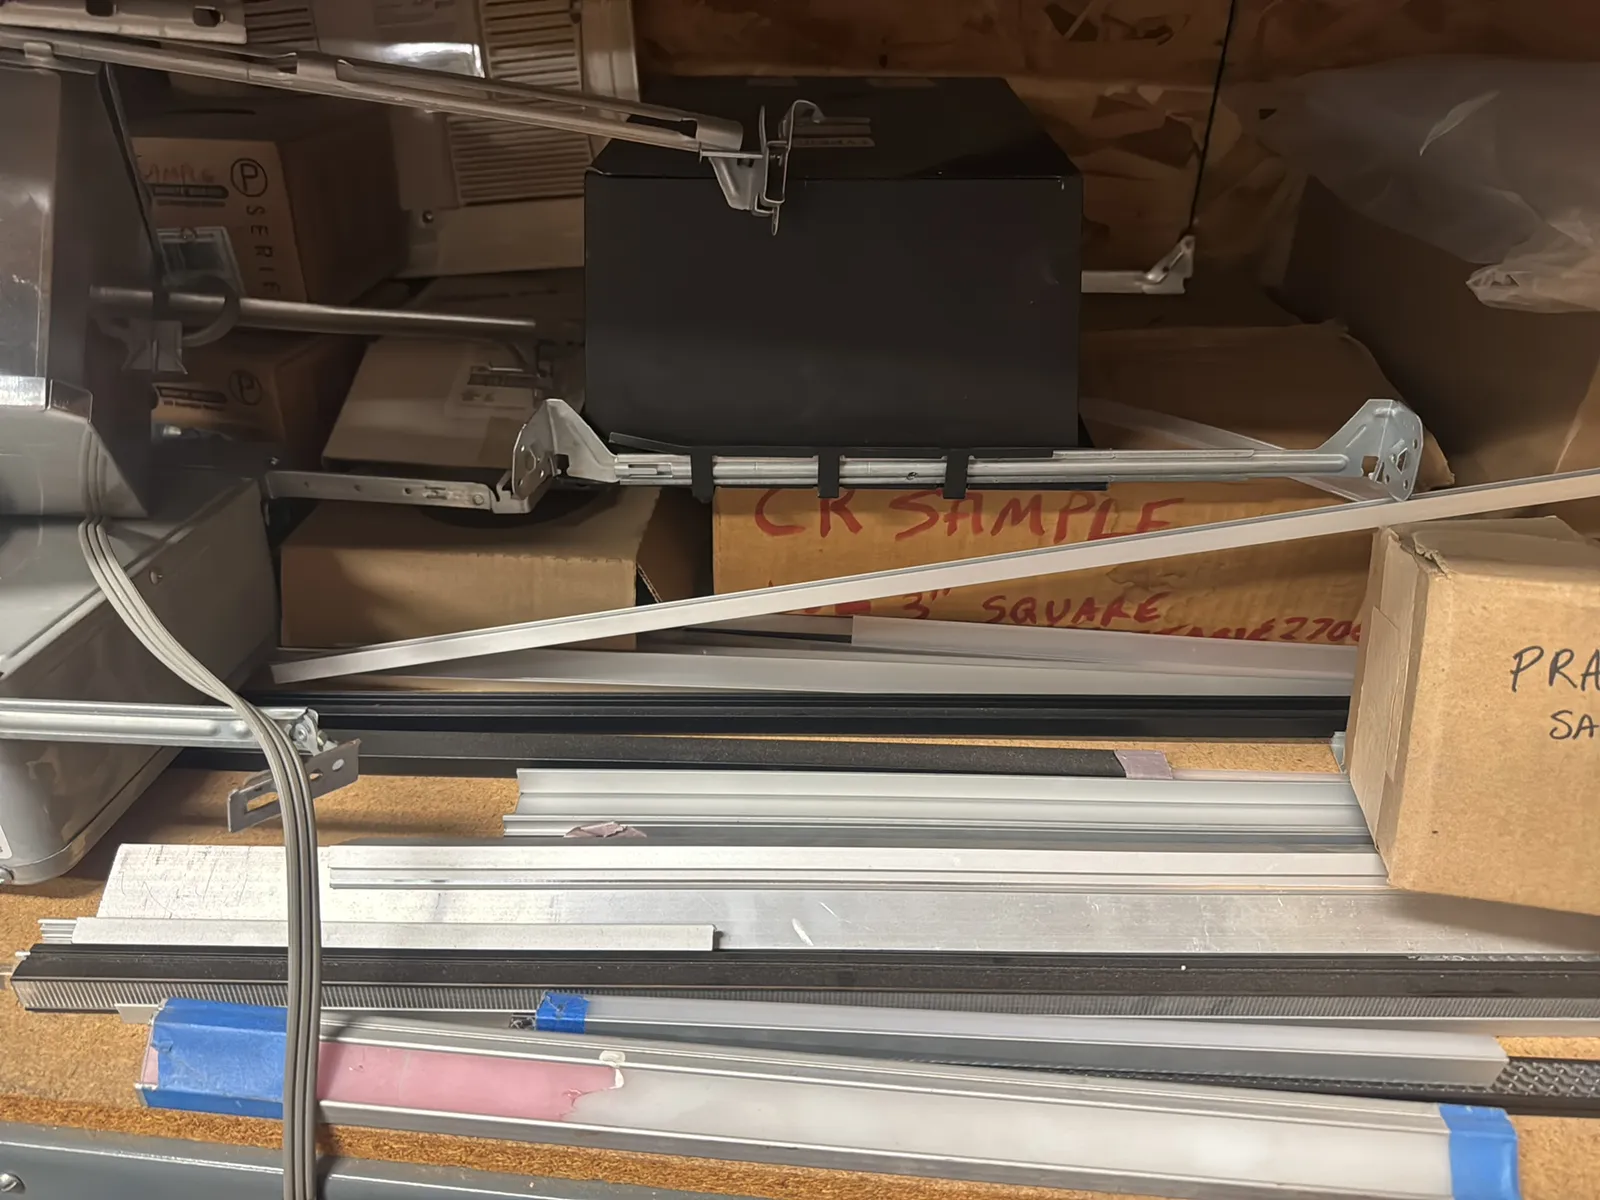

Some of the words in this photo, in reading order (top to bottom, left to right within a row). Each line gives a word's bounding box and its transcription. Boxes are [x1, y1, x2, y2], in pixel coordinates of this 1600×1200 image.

[755, 488, 863, 538] CR
[889, 489, 1184, 543] SAMPLE
[982, 592, 1172, 627] SQUARE
[1549, 709, 1600, 740] SA
